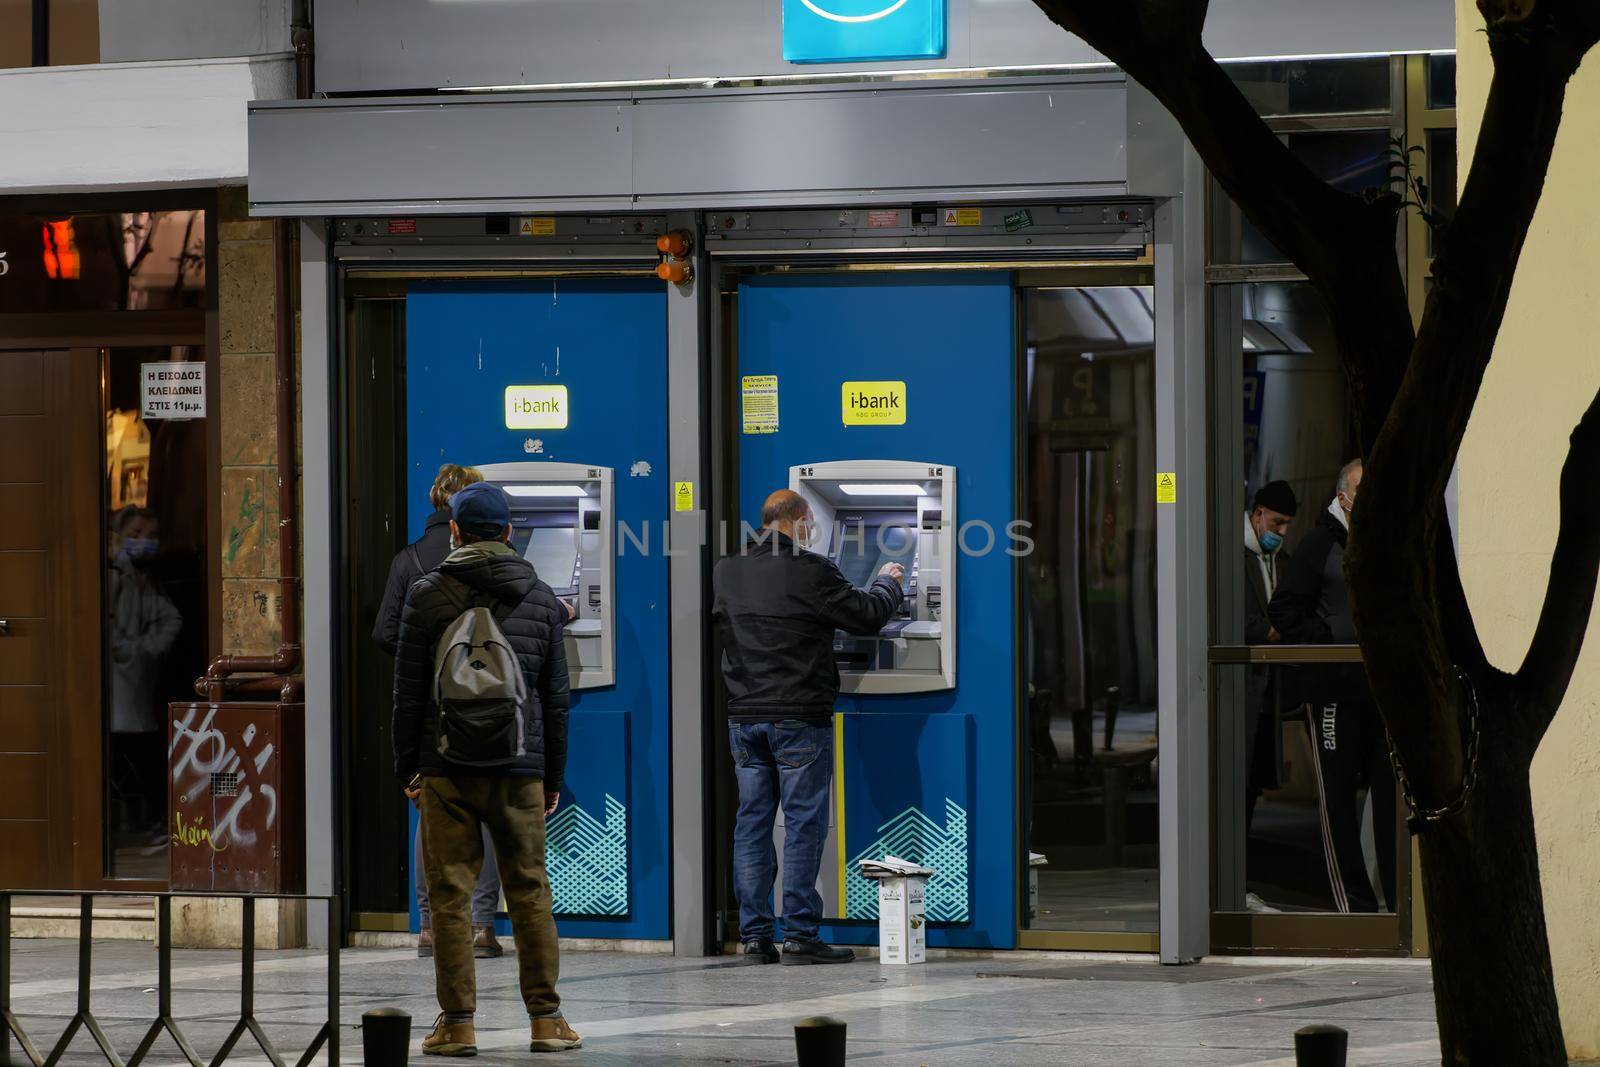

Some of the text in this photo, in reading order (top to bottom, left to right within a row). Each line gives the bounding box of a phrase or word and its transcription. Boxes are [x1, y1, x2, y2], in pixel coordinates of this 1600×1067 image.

[148, 371, 201, 380] Η ΕΙΣΟΔΟΣ
[148, 386, 202, 395] ΚΛΕΙΔΩΝΕΙ
[514, 397, 560, 413] i-bank
[851, 392, 899, 408] i-bank
[148, 401, 202, 411] ΣΤΙΣ 11μ.μ.
